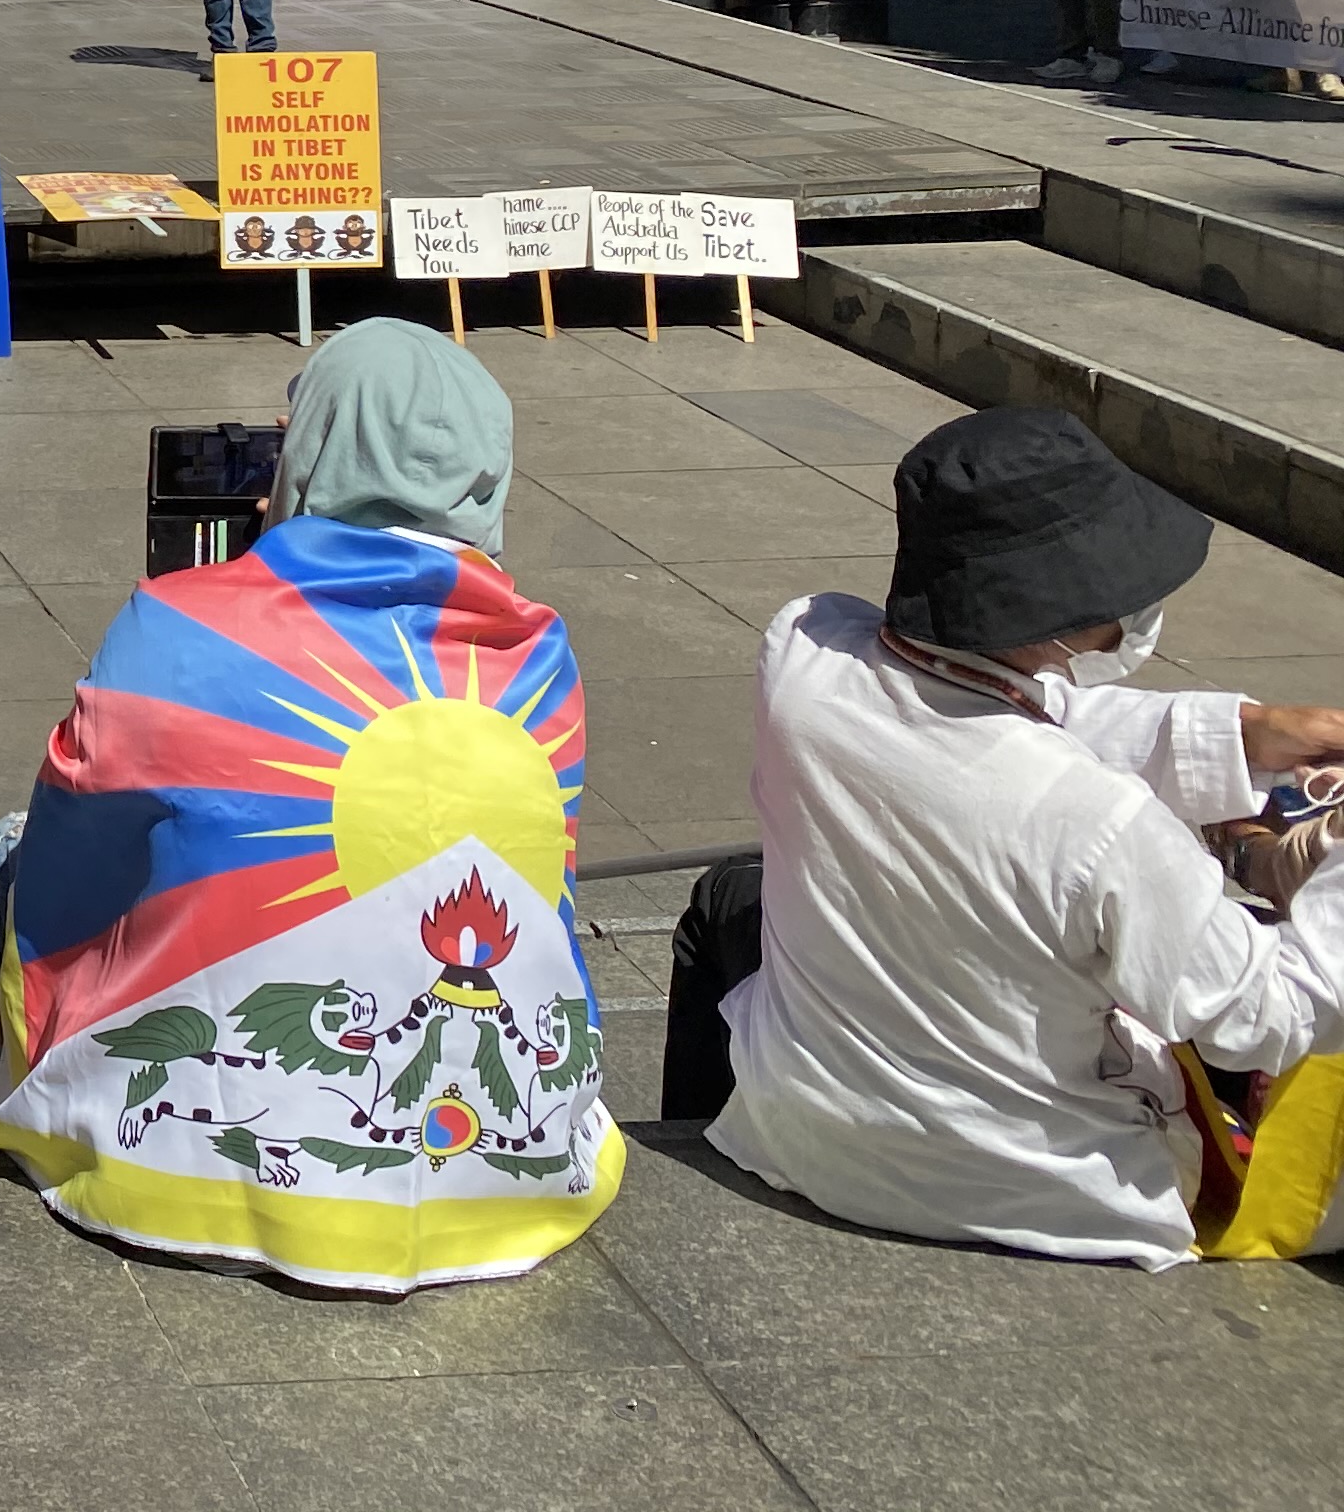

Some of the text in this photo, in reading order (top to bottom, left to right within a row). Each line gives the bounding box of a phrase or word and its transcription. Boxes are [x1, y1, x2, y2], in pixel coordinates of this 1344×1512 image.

[1219, 6, 1315, 44] Alliance
[259, 58, 343, 83] 107
[271, 91, 325, 108] SELF
[226, 114, 370, 133] IMMOLATION
[253, 139, 347, 157] IN TIBET
[241, 163, 359, 181] IS ANYONE
[227, 186, 373, 206] WATCHING??
[407, 208, 469, 230] Tibet
[598, 194, 695, 222] People of the
[701, 201, 755, 228] Save
[551, 212, 580, 232] CCP
[602, 216, 679, 239] Australia
[415, 231, 479, 254] Needs
[601, 241, 689, 265] Support Us
[416, 253, 460, 274] You.
